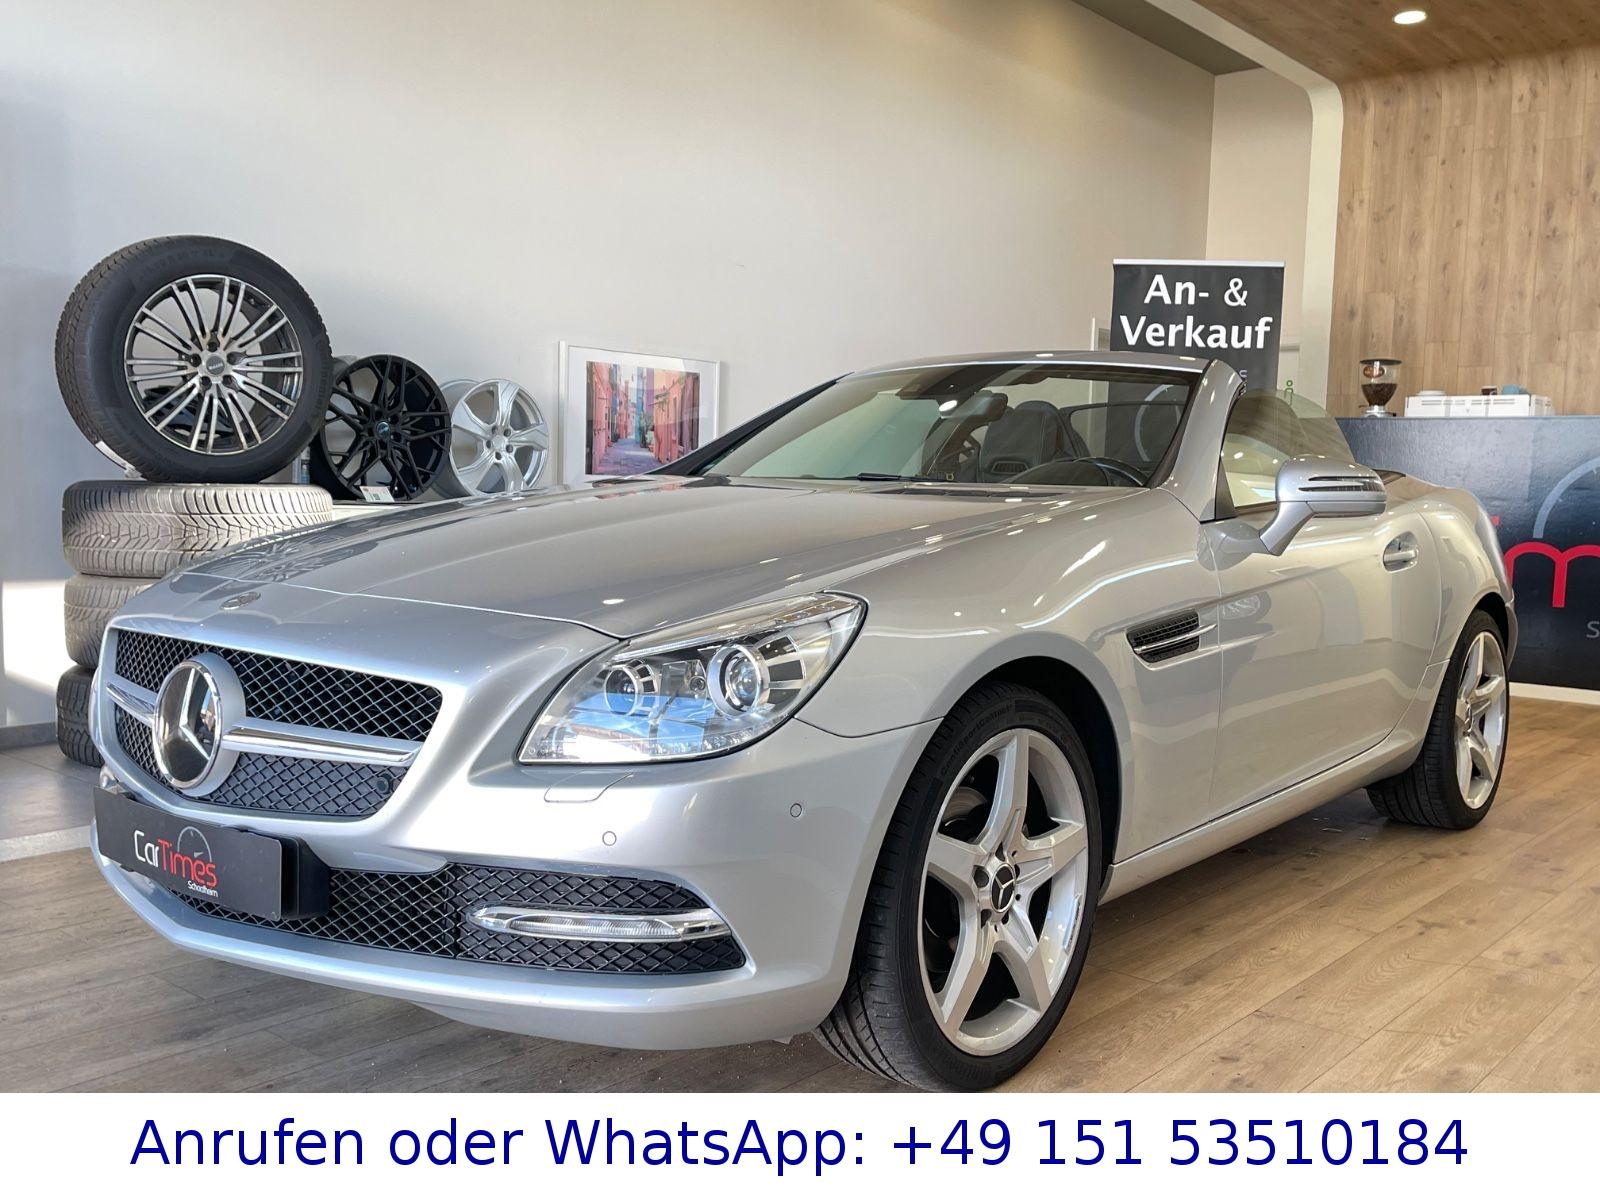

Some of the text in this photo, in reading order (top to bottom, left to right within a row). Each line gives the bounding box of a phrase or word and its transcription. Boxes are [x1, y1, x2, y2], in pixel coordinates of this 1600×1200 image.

[1144, 274, 1248, 307] An- &
[1119, 315, 1273, 349] Verkauf
[134, 829, 217, 888] CarTimes
